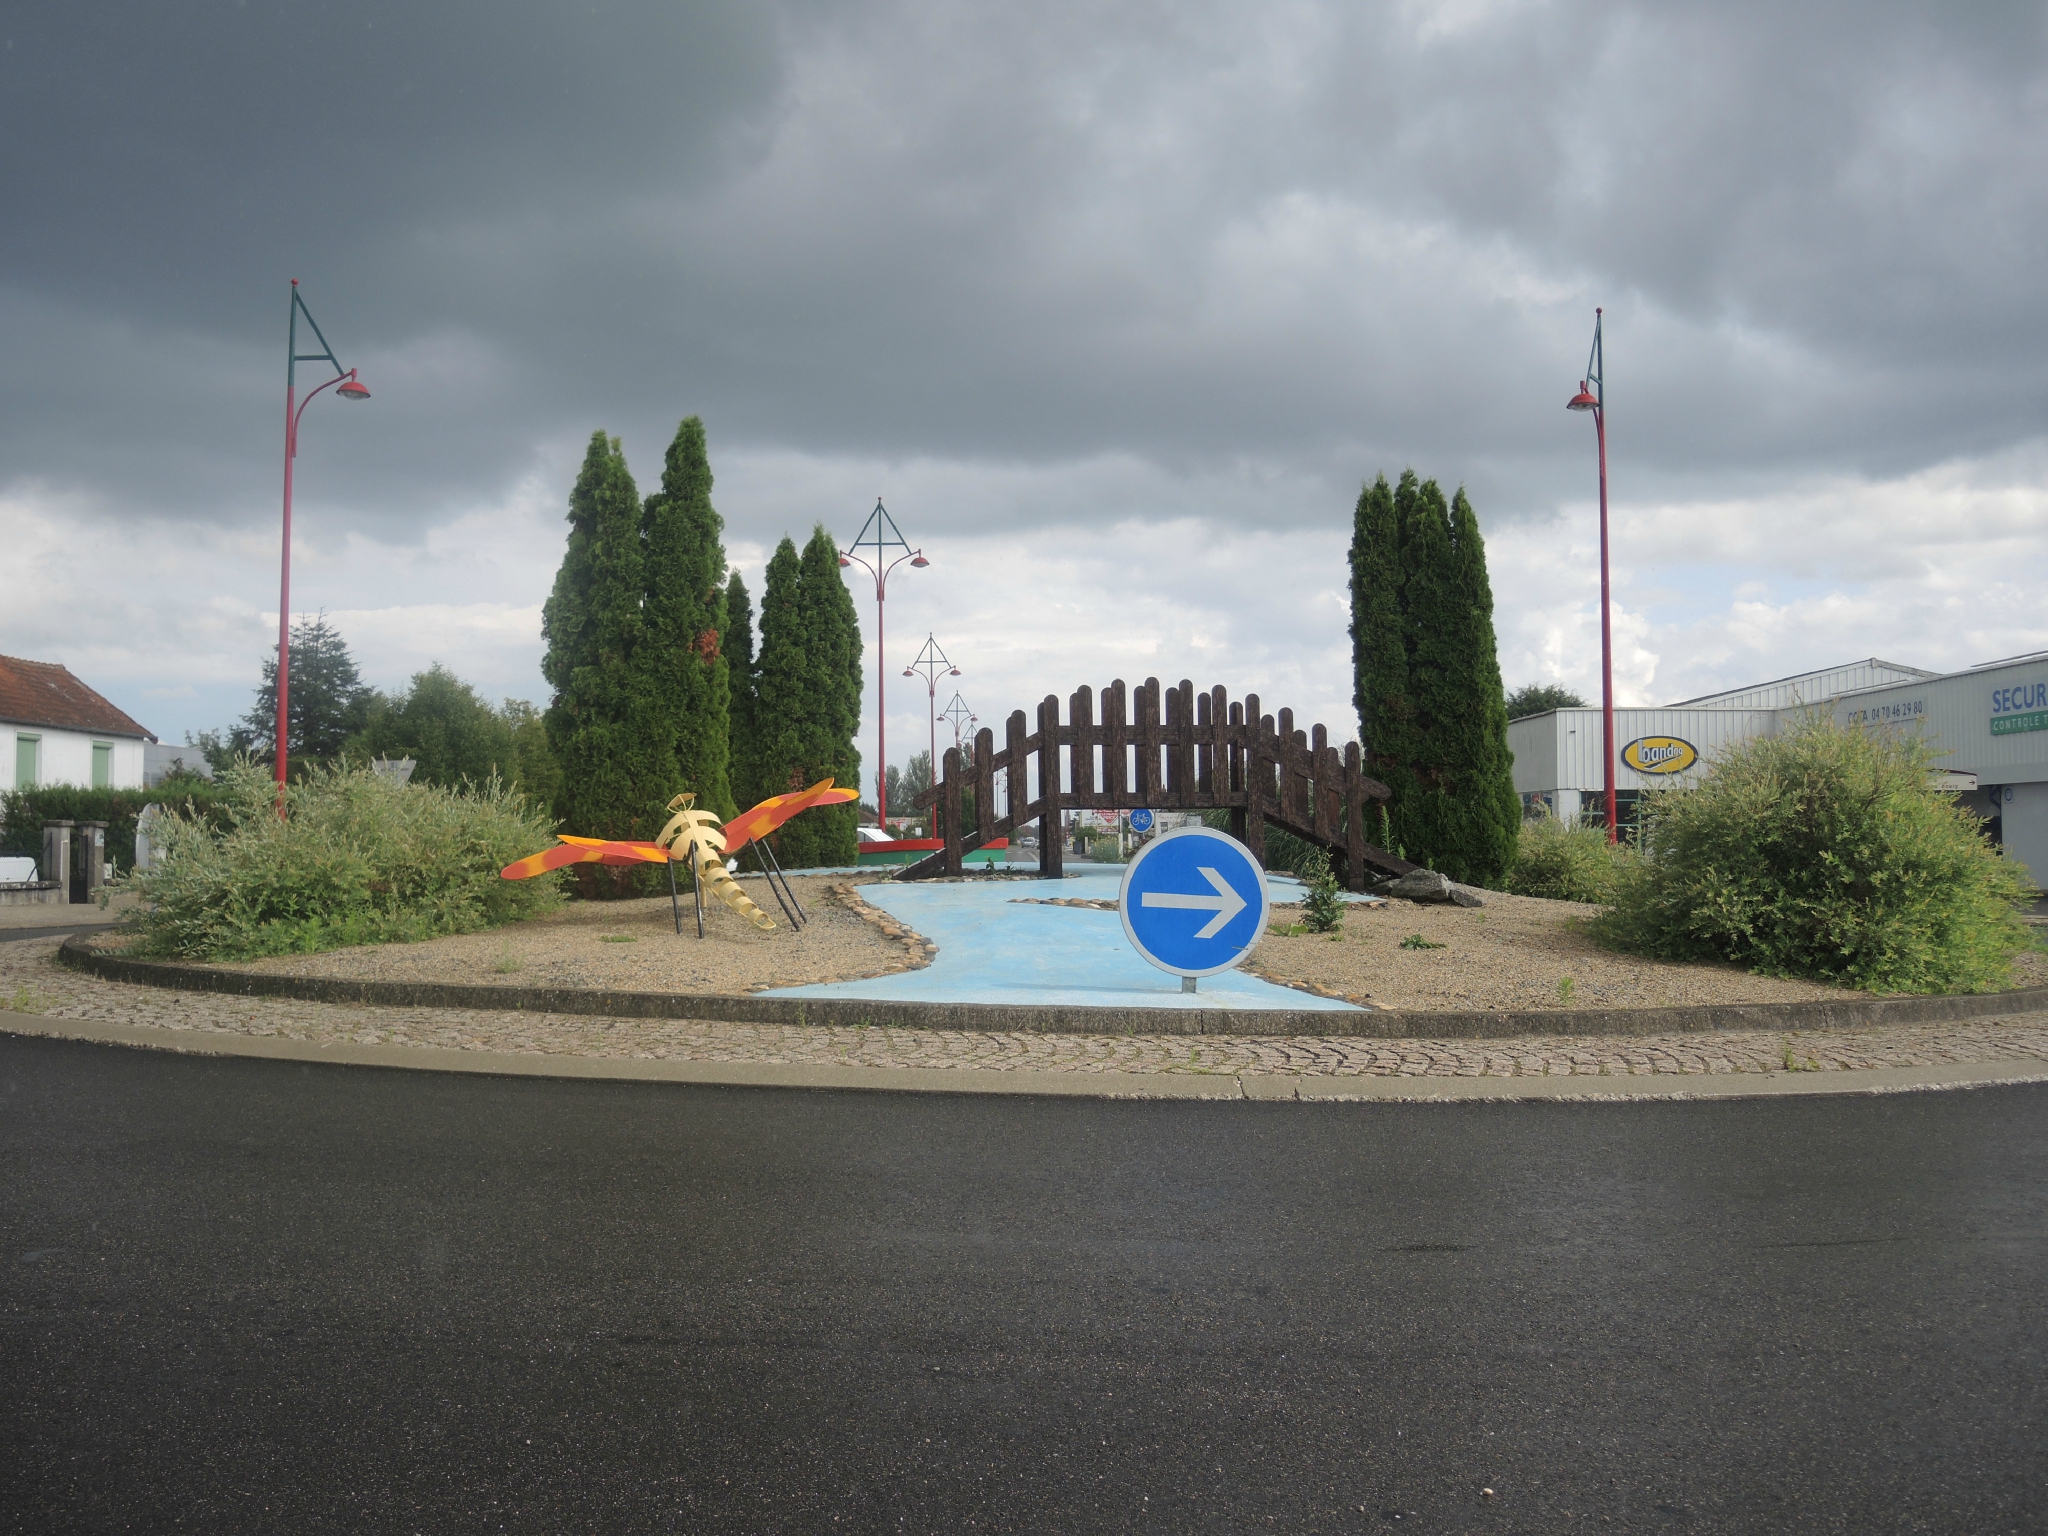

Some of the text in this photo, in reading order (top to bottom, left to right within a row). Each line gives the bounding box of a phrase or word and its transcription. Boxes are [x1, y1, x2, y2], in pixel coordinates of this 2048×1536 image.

[1992, 683, 2048, 713] SECUR
[1871, 708, 1880, 721] 04
[1881, 706, 1890, 719] 70
[1892, 704, 1901, 717] 46
[1902, 702, 1912, 716] 29
[1913, 701, 1923, 714] 80
[1993, 715, 2040, 731] CONTROLE
